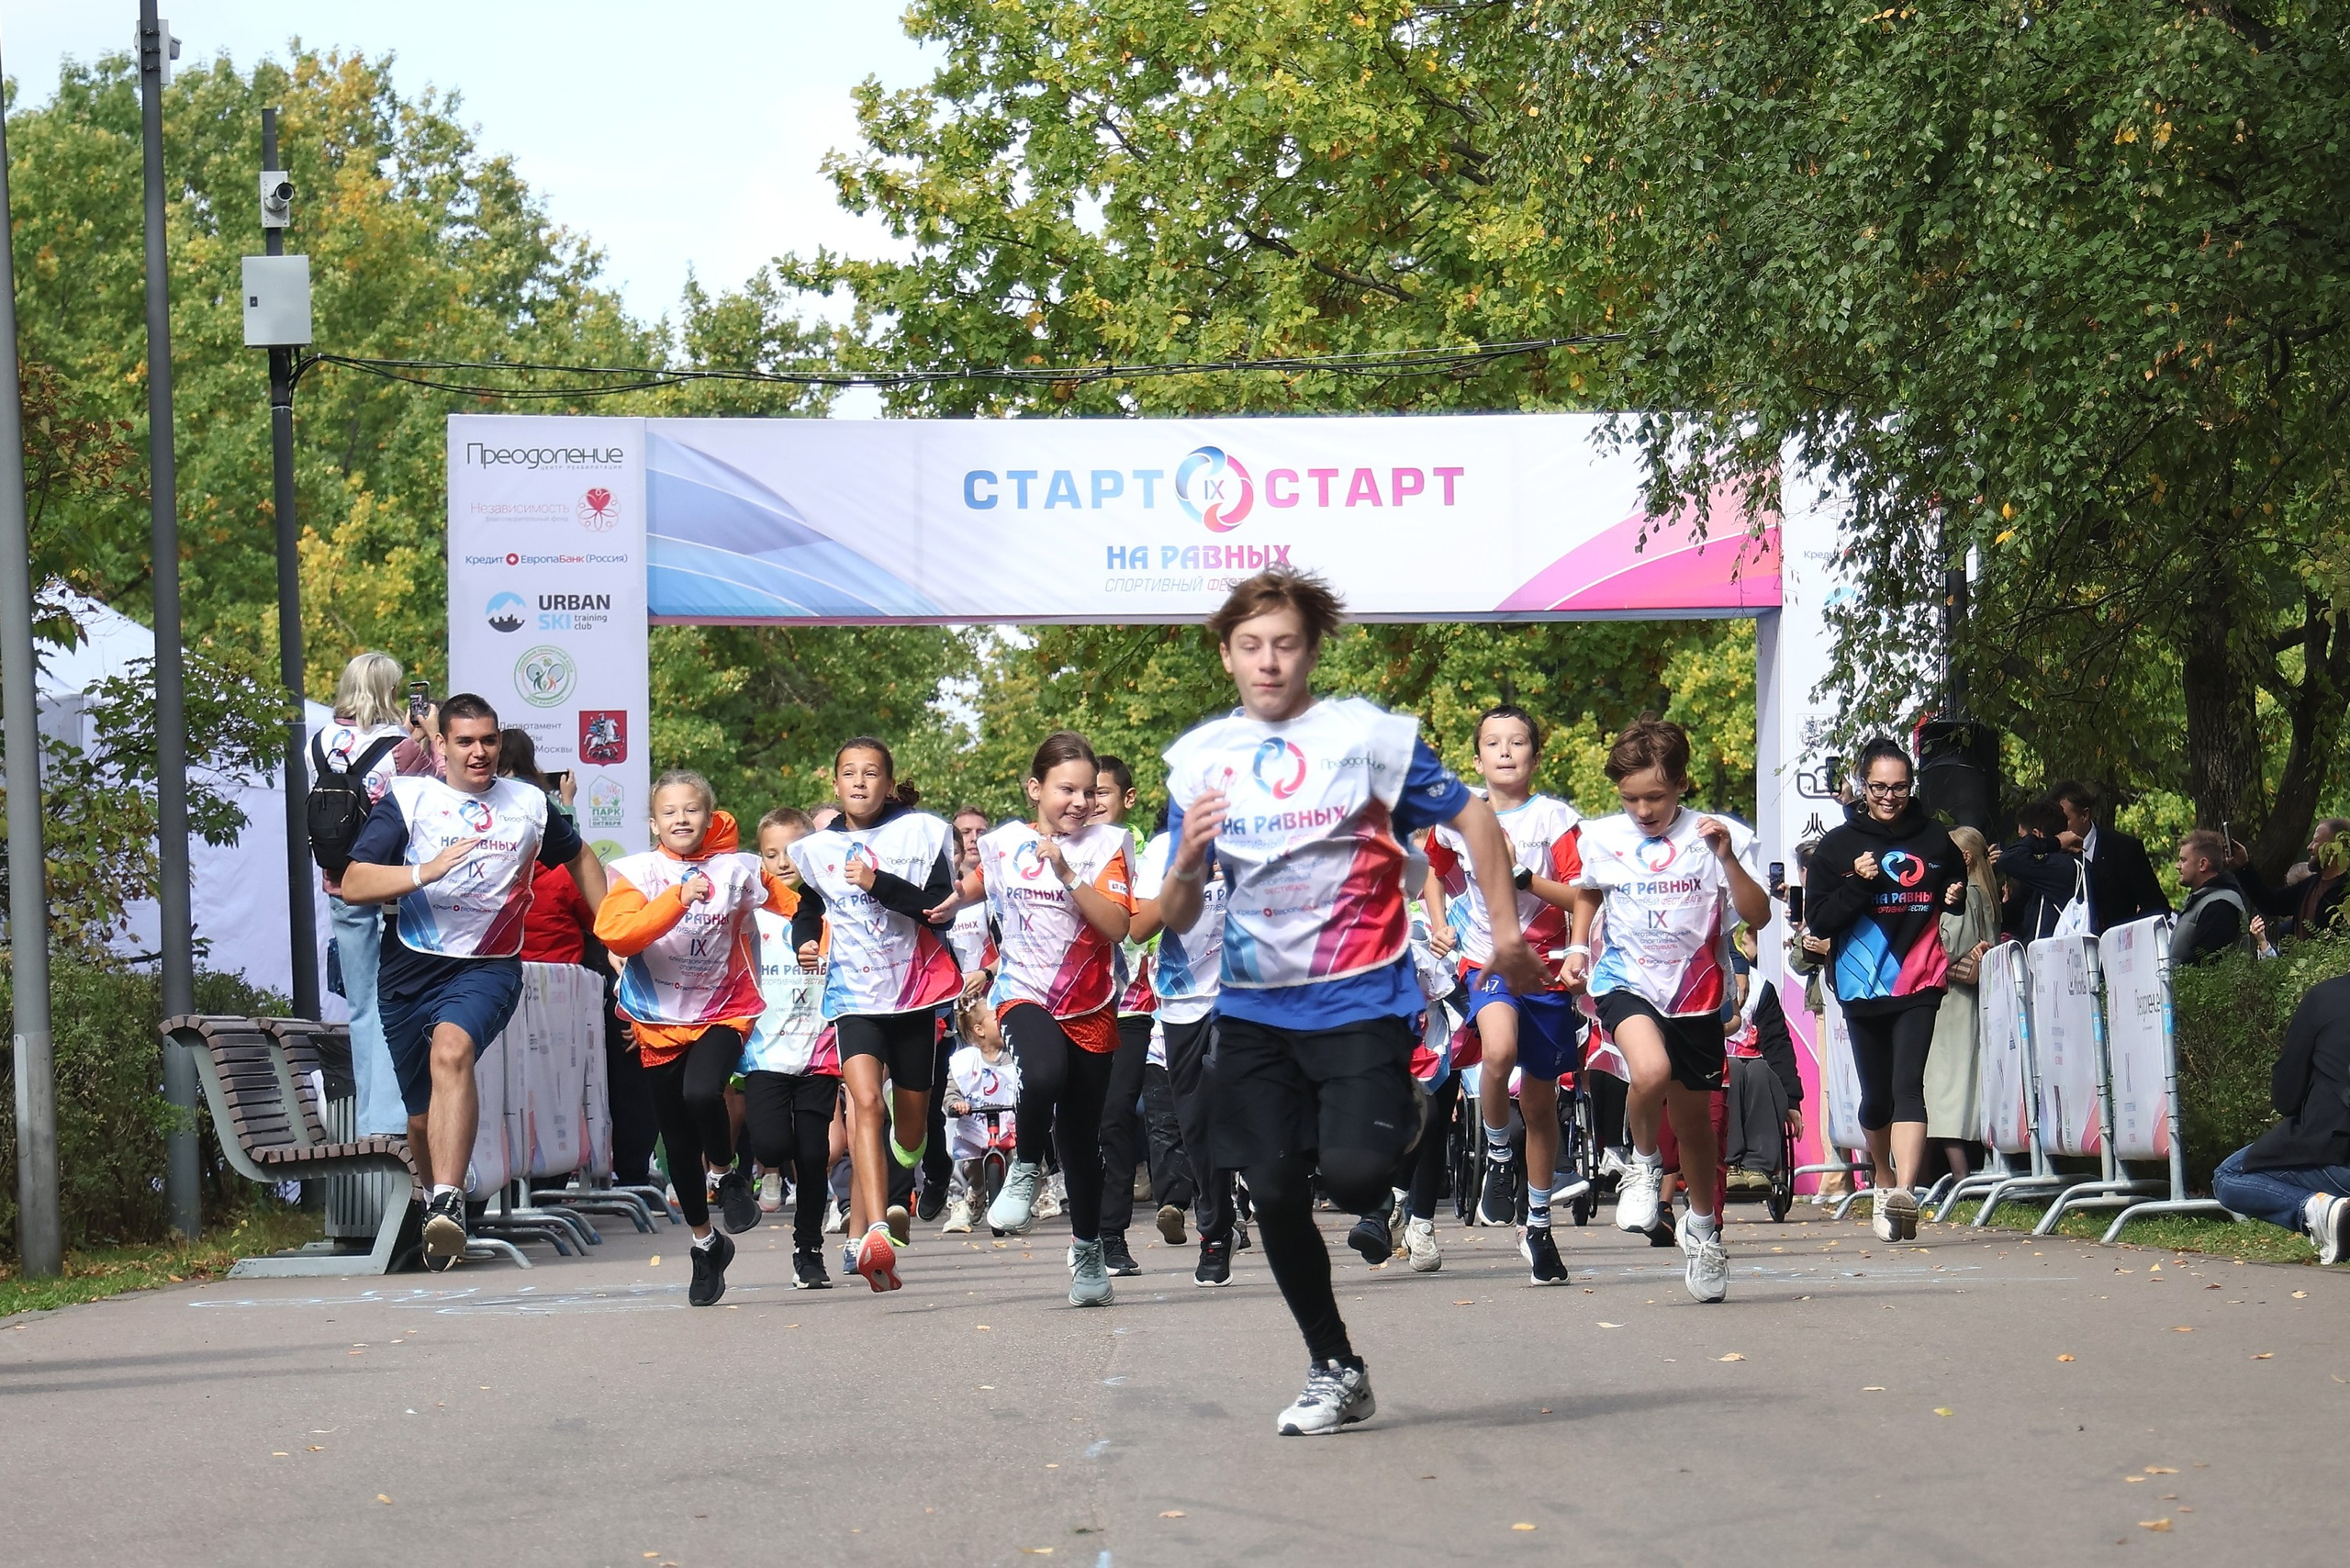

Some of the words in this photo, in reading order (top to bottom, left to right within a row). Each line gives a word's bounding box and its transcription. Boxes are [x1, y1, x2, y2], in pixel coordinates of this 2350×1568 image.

[466, 442, 623, 469] Преодоление
[962, 469, 1164, 510] СТАРТ
[1203, 480, 1225, 501] IX
[1264, 466, 1465, 509] СТАРТ
[470, 502, 570, 514] Независимость
[465, 555, 504, 565] Кредит
[586, 554, 628, 564] (Россия)
[1106, 545, 1149, 570] НА
[1160, 544, 1292, 570] РАВНЫХ
[1104, 576, 1203, 593] СПОРТИВНЫЙ
[538, 594, 610, 610] URBAN
[538, 614, 570, 631] SKI
[575, 614, 608, 623] training
[575, 622, 592, 630] club
[499, 722, 562, 731] Департамент
[592, 808, 621, 816] ПАРК
[1222, 815, 1247, 835] НА
[1254, 804, 1347, 834] РАВНЫХ
[476, 838, 518, 852] ВНЫХ
[468, 861, 487, 879] IX
[1006, 886, 1066, 902] РАВНЫХ
[1636, 878, 1702, 895] РАВНЫХ
[1891, 890, 1933, 904] РАВНЫ
[684, 912, 731, 925] РАВНЫ
[952, 920, 979, 933] ВНЫХ
[1018, 913, 1035, 933] IX
[1648, 910, 1669, 929] IX
[689, 938, 708, 957] IX
[761, 964, 779, 976] НА
[792, 988, 809, 1004] IX
